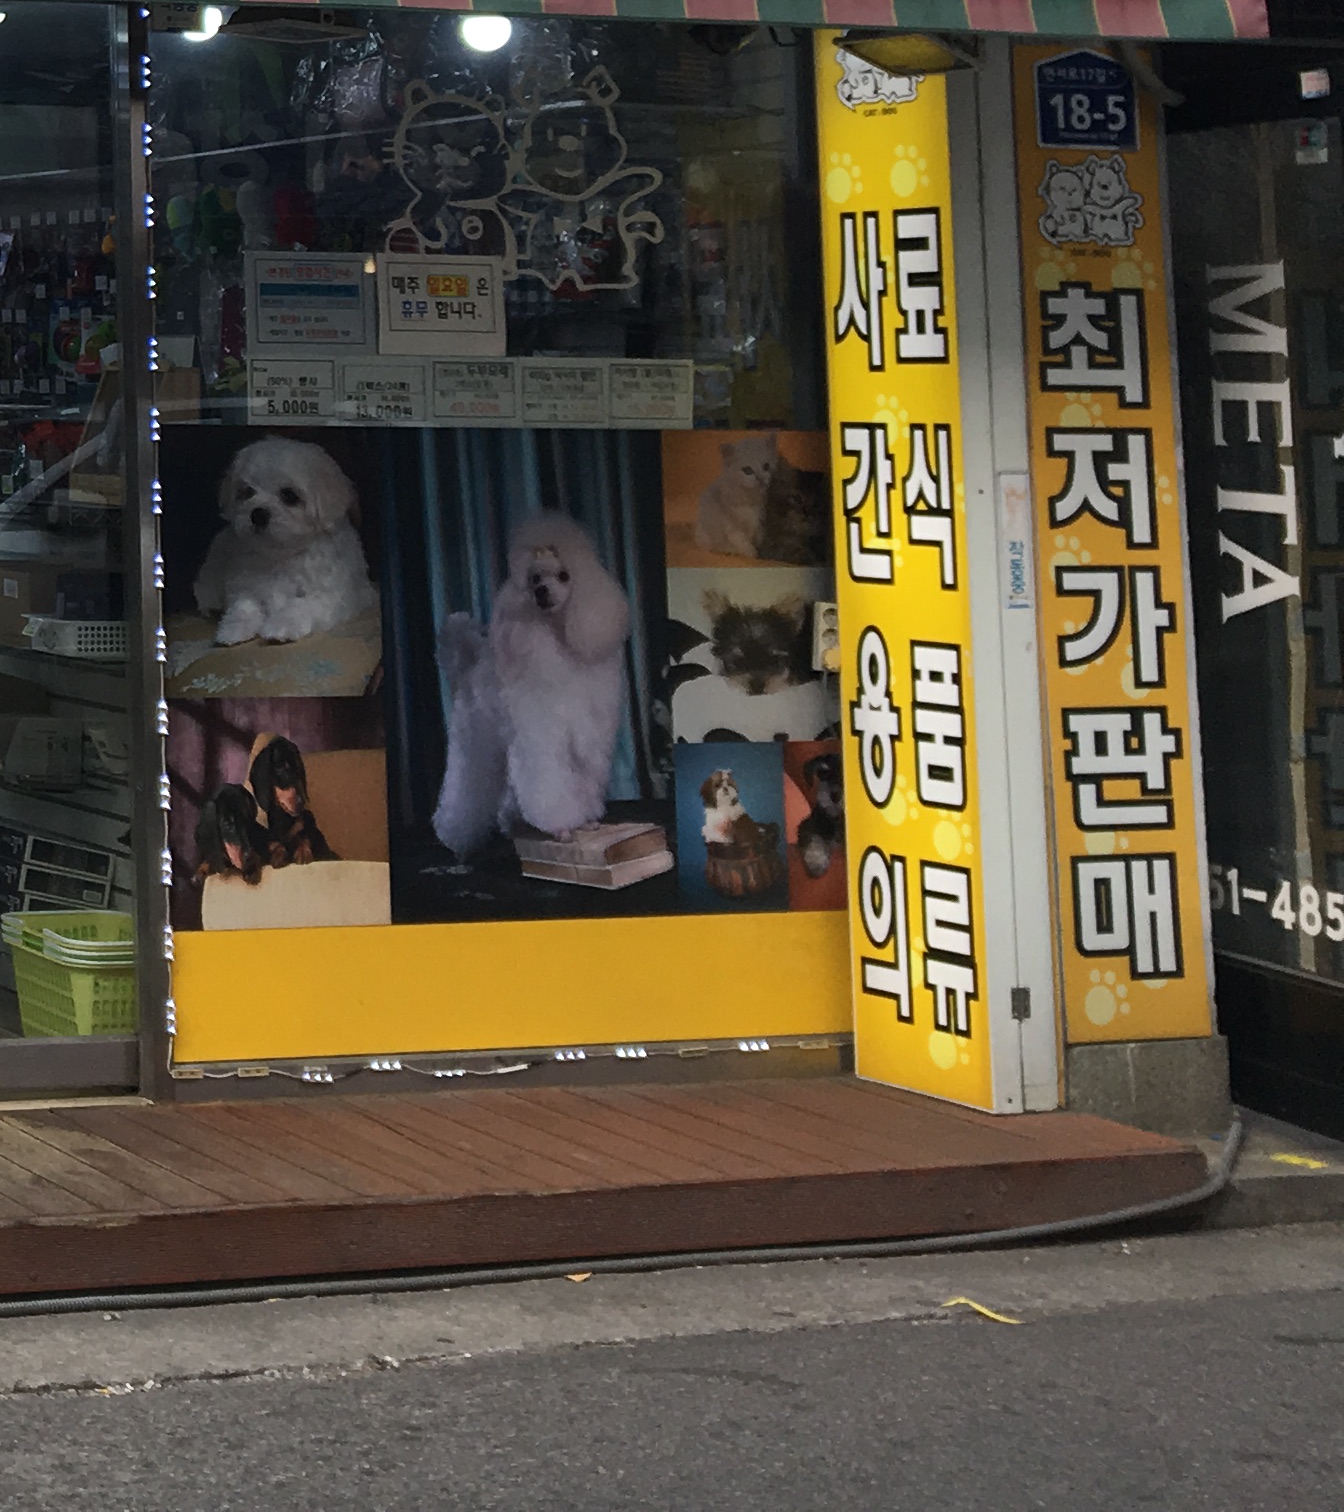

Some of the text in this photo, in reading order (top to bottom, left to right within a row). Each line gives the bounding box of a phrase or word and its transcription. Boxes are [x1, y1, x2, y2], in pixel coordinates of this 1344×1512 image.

[1050, 93, 1128, 132] 18-5
[391, 276, 489, 296] 매주 일요일 은
[401, 300, 482, 320] 휴무 합니다.
[835, 207, 950, 372] 사료
[840, 423, 957, 590] 간식
[1208, 258, 1300, 625] META
[1039, 281, 1185, 980] 최저가판매
[850, 625, 967, 810] 용품
[859, 845, 979, 1037] 의류
